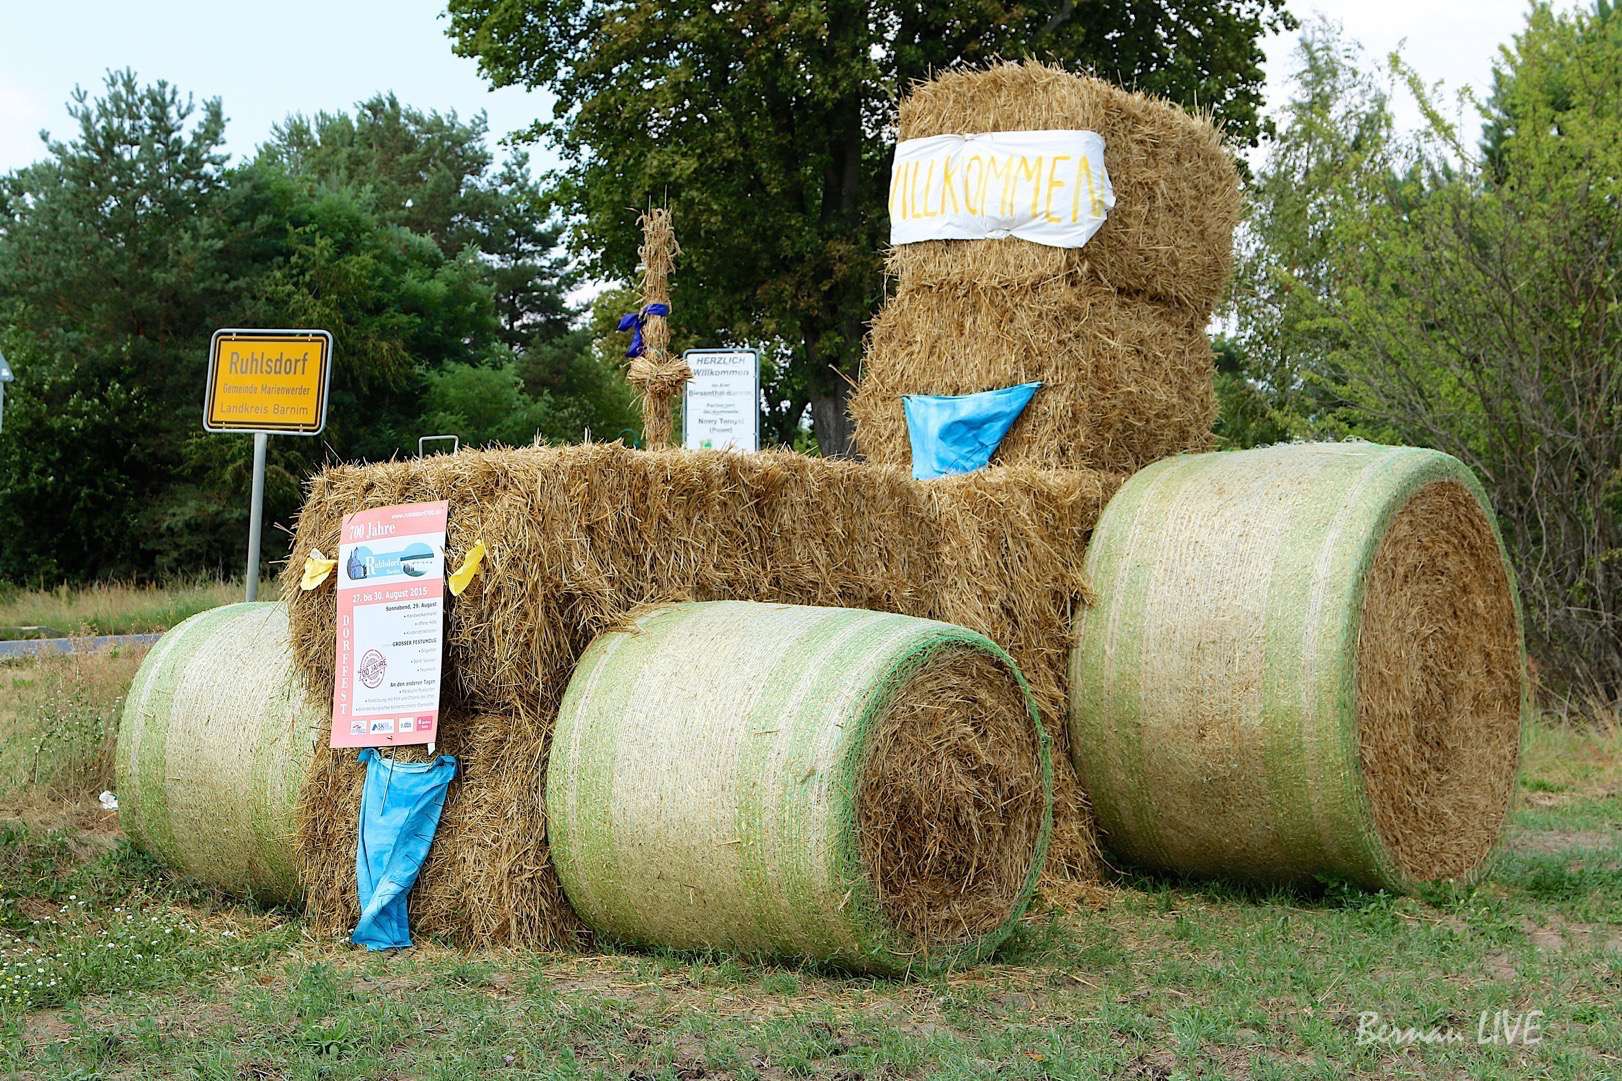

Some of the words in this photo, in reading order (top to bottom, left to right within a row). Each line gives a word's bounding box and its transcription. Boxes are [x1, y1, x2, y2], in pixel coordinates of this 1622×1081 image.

[229, 351, 309, 375] Ruhlsdorf
[696, 356, 746, 365] HERZLICH
[693, 368, 750, 377] Willkommen
[223, 383, 257, 394] Gemeinde
[261, 384, 311, 396] Marienwerder
[220, 401, 269, 415] Landkreis
[272, 403, 309, 416] Barnim
[350, 524, 365, 541] 700
[365, 521, 396, 539] Jahre
[352, 594, 362, 603] 27.
[363, 592, 373, 602] bis
[373, 591, 384, 601] 30.
[385, 589, 409, 601] August
[410, 586, 428, 596] 2015
[385, 604, 411, 613] Sonnabend,
[421, 601, 438, 609] August
[392, 640, 412, 648] GROSSER
[340, 615, 350, 714] DORFFEST
[424, 678, 436, 686] Tagen
